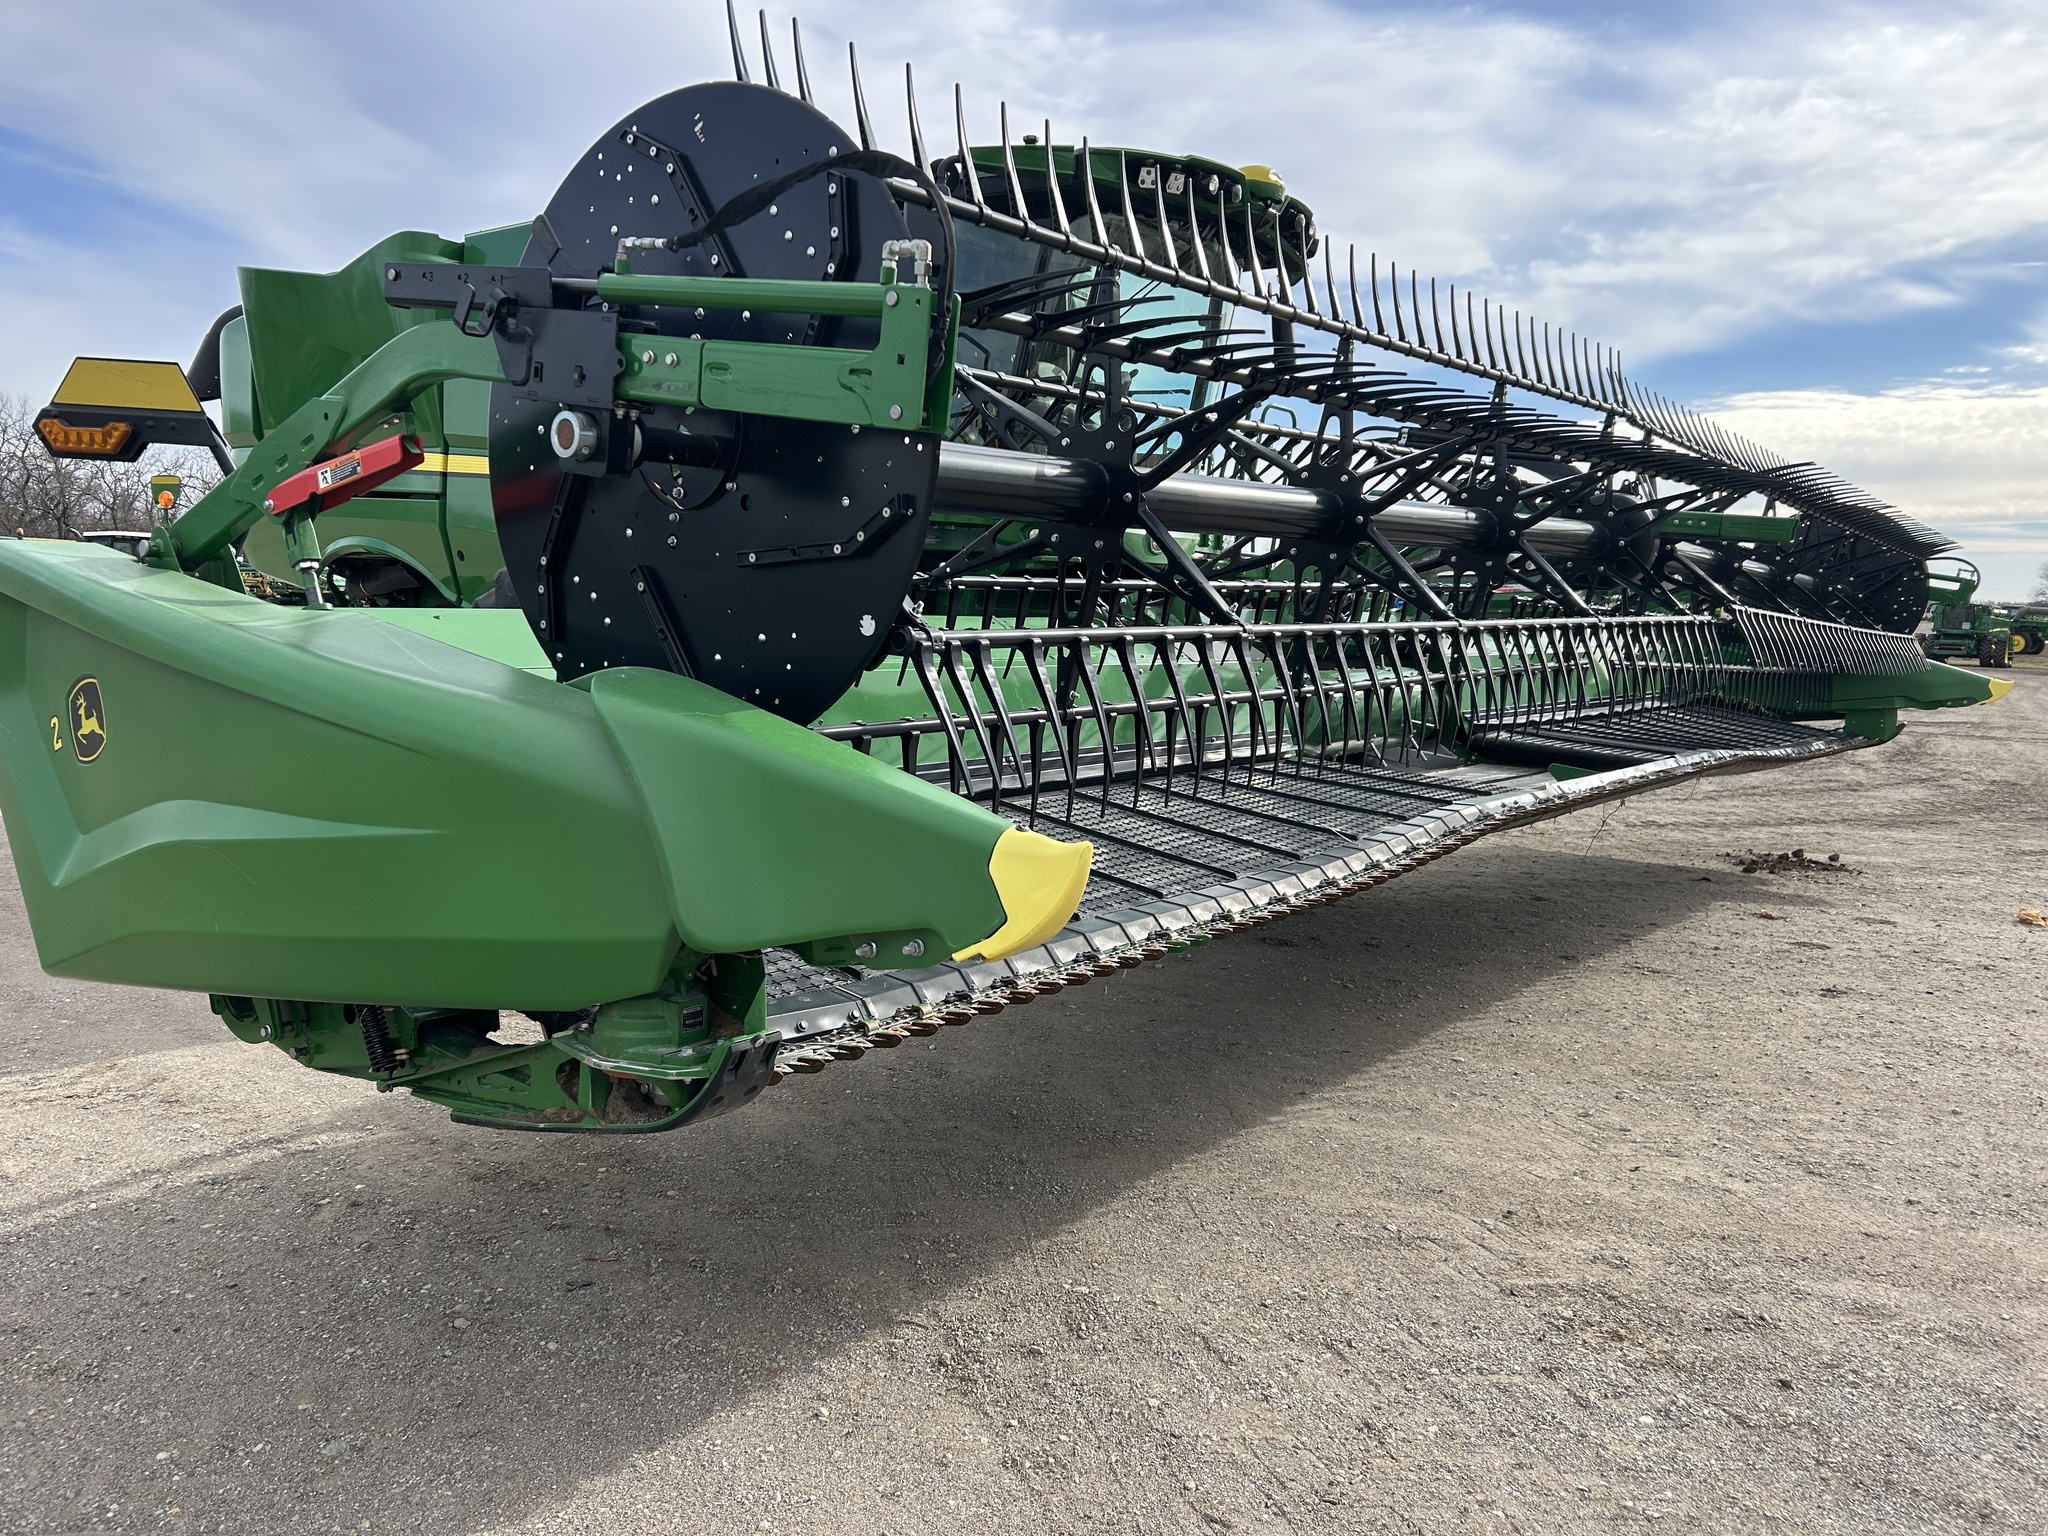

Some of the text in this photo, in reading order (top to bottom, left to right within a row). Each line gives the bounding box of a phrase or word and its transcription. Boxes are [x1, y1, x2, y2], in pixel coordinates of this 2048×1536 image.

[428, 271, 434, 282] 3
[463, 273, 469, 284] 2
[50, 715, 63, 751] 2
